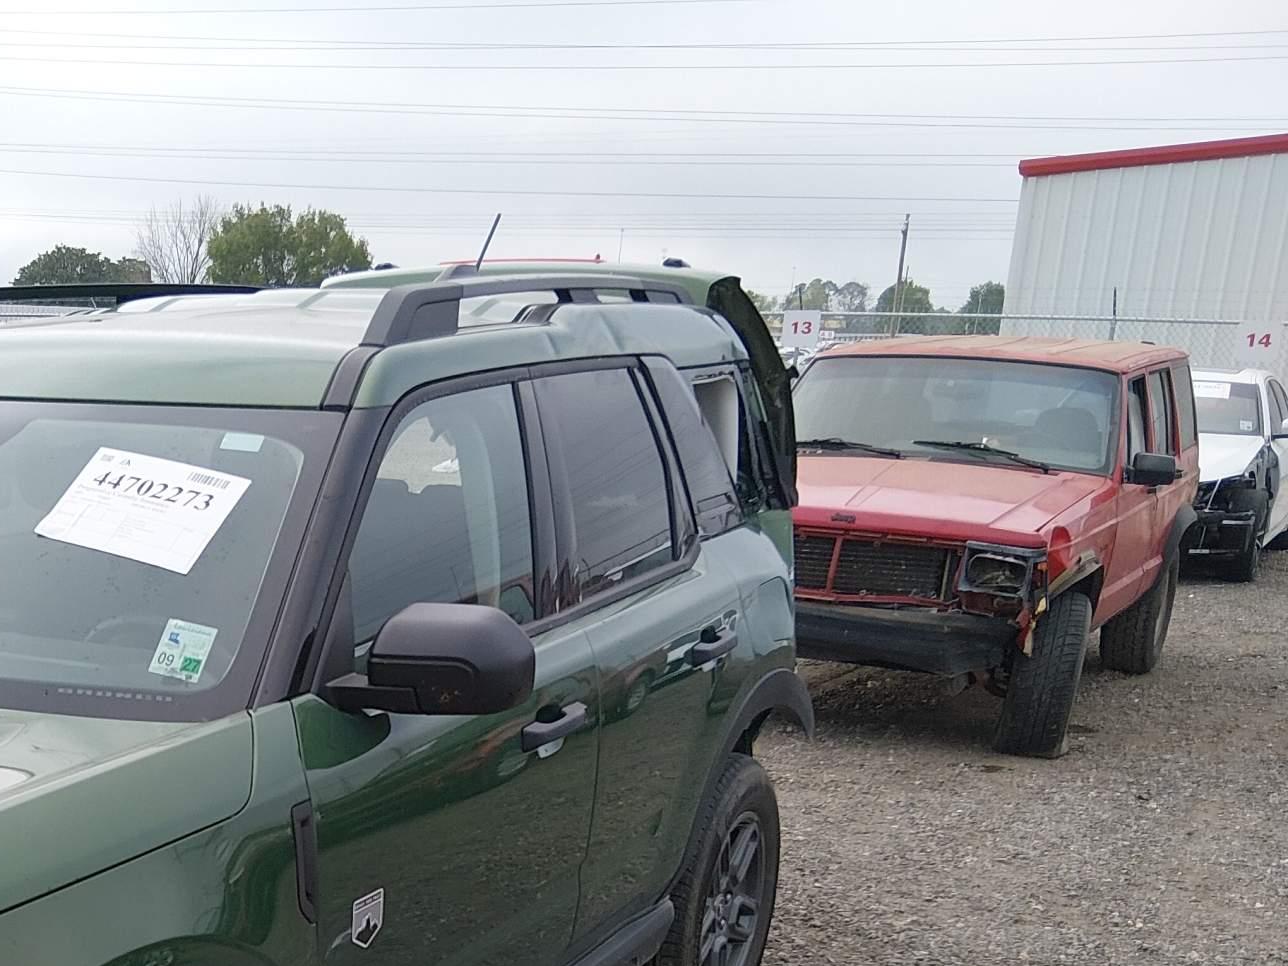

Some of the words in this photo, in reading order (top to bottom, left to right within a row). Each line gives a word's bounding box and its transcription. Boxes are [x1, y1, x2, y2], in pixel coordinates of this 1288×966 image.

[791, 321, 812, 335] 13
[1247, 333, 1272, 348] 14
[93, 471, 214, 511] 44702273
[158, 651, 175, 666] 09
[183, 657, 201, 674] 27
